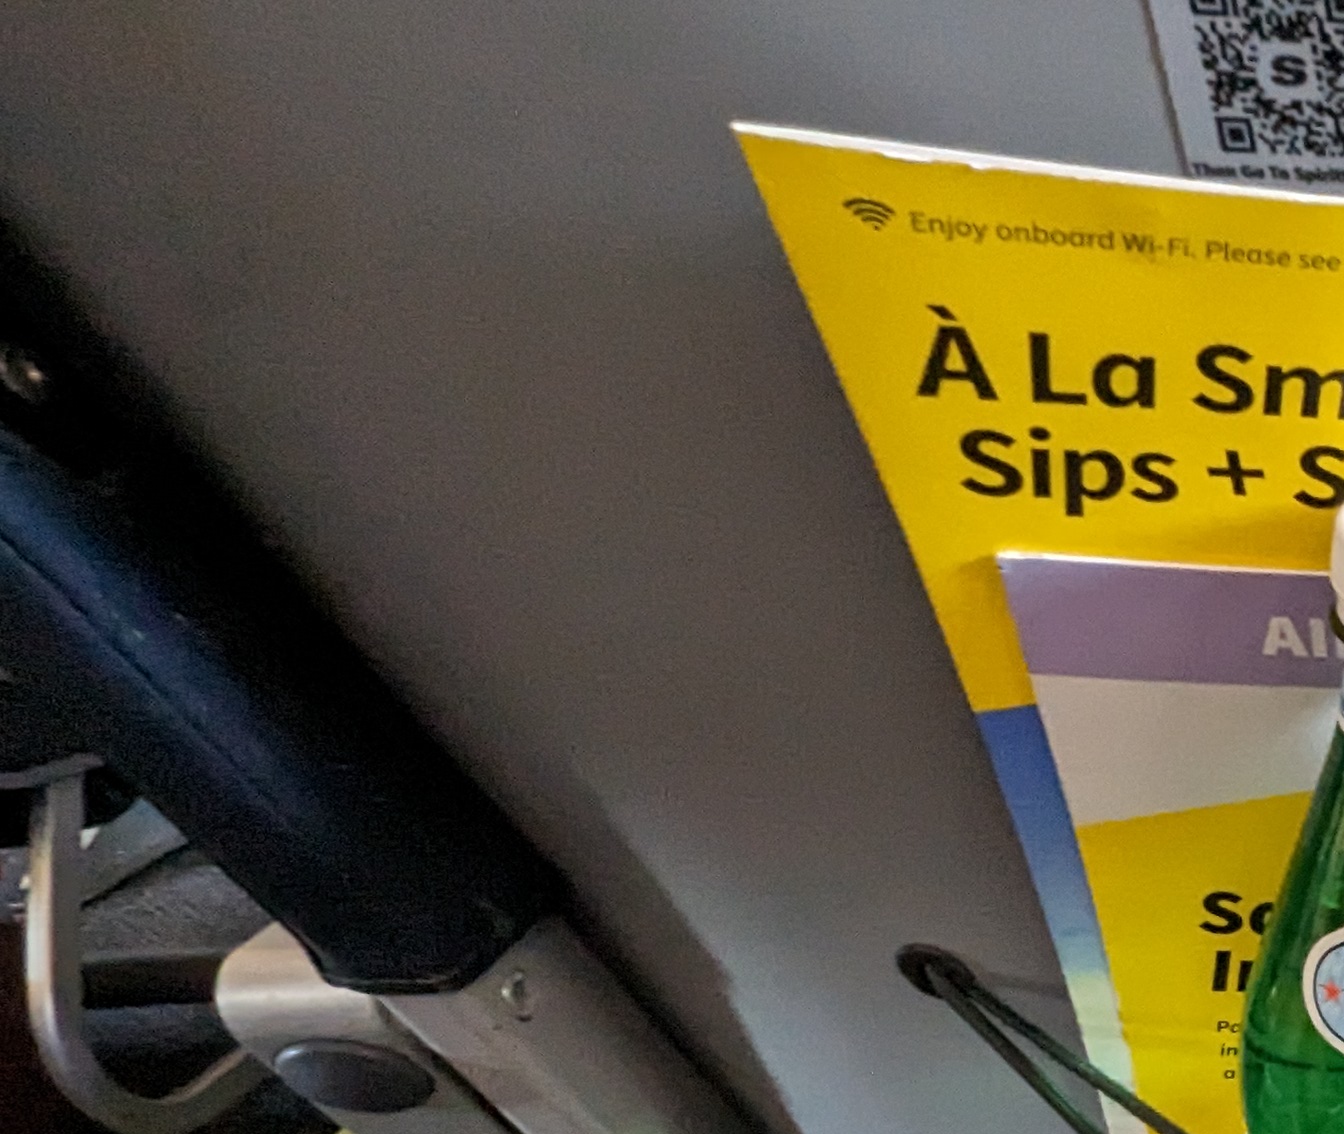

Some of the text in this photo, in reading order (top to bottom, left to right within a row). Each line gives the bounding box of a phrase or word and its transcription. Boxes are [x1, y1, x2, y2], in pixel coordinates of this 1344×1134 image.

[909, 211, 987, 244] Enjoy
[996, 221, 1115, 250] onboard
[1205, 240, 1291, 268] Please
[1300, 252, 1341, 272] see
[1028, 331, 1156, 409] La
[959, 426, 1180, 517] Sips
[1207, 449, 1265, 496] +
